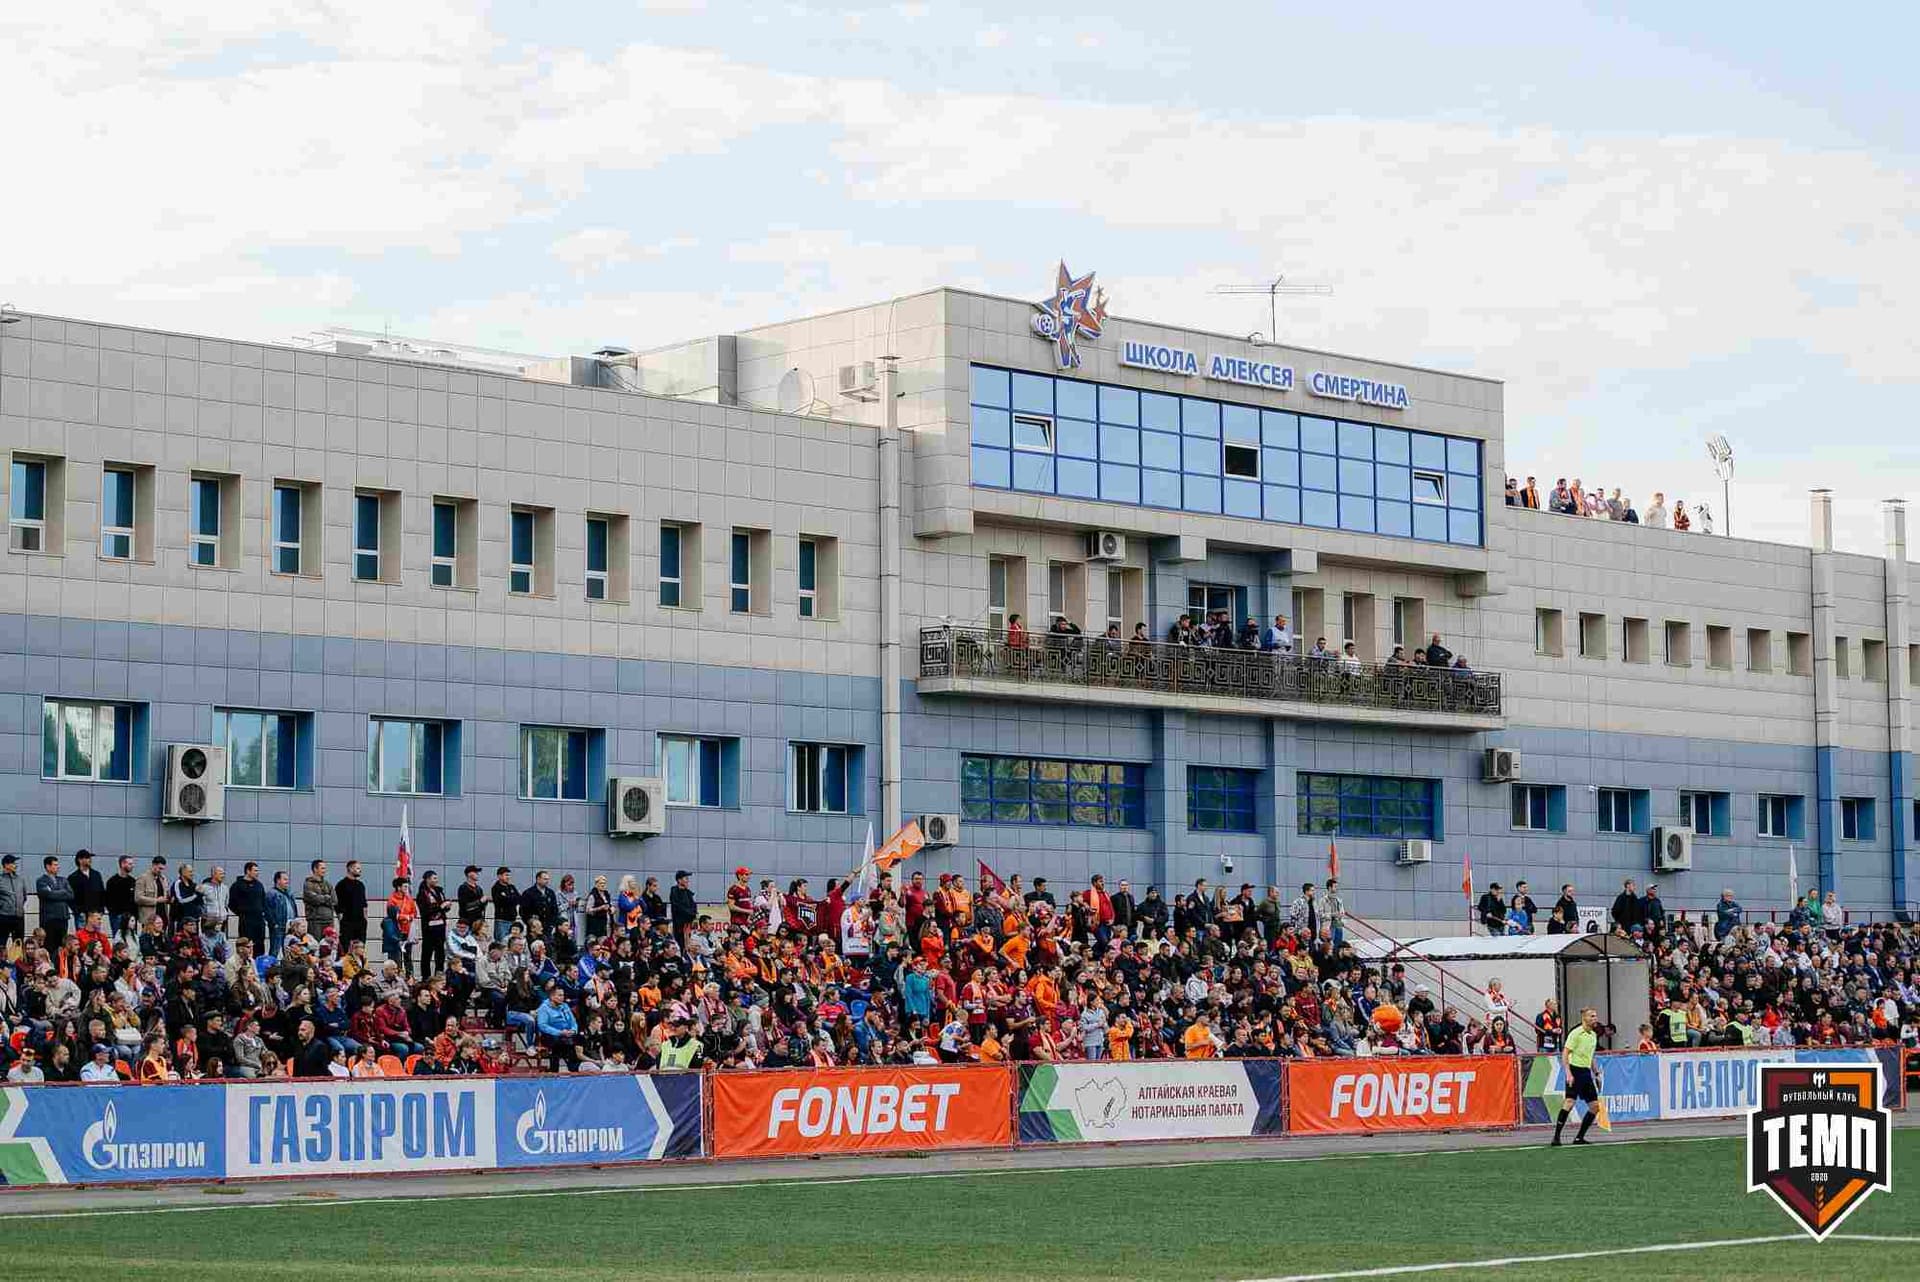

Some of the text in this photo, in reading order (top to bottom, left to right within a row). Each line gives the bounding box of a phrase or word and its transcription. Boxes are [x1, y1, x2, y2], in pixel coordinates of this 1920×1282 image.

[1125, 342, 1408, 407] ШКОЛА АЛЕКСЕЯ СМЕРТИНА
[1138, 1084, 1237, 1100] АЛТАЙСКАЯ КРАЕВАЯ
[1330, 1071, 1476, 1119] FONBET
[1669, 1059, 1784, 1110] ГАЗПРО
[249, 1091, 475, 1163] ГАЗПРОМ
[768, 1083, 960, 1139] FONBET
[1131, 1103, 1244, 1119] НОТАРИАЛЬНАЯ ПАЛАТА
[118, 1142, 205, 1169] ГАЗПРОМ
[550, 1128, 624, 1153] ГАЗПРОМ
